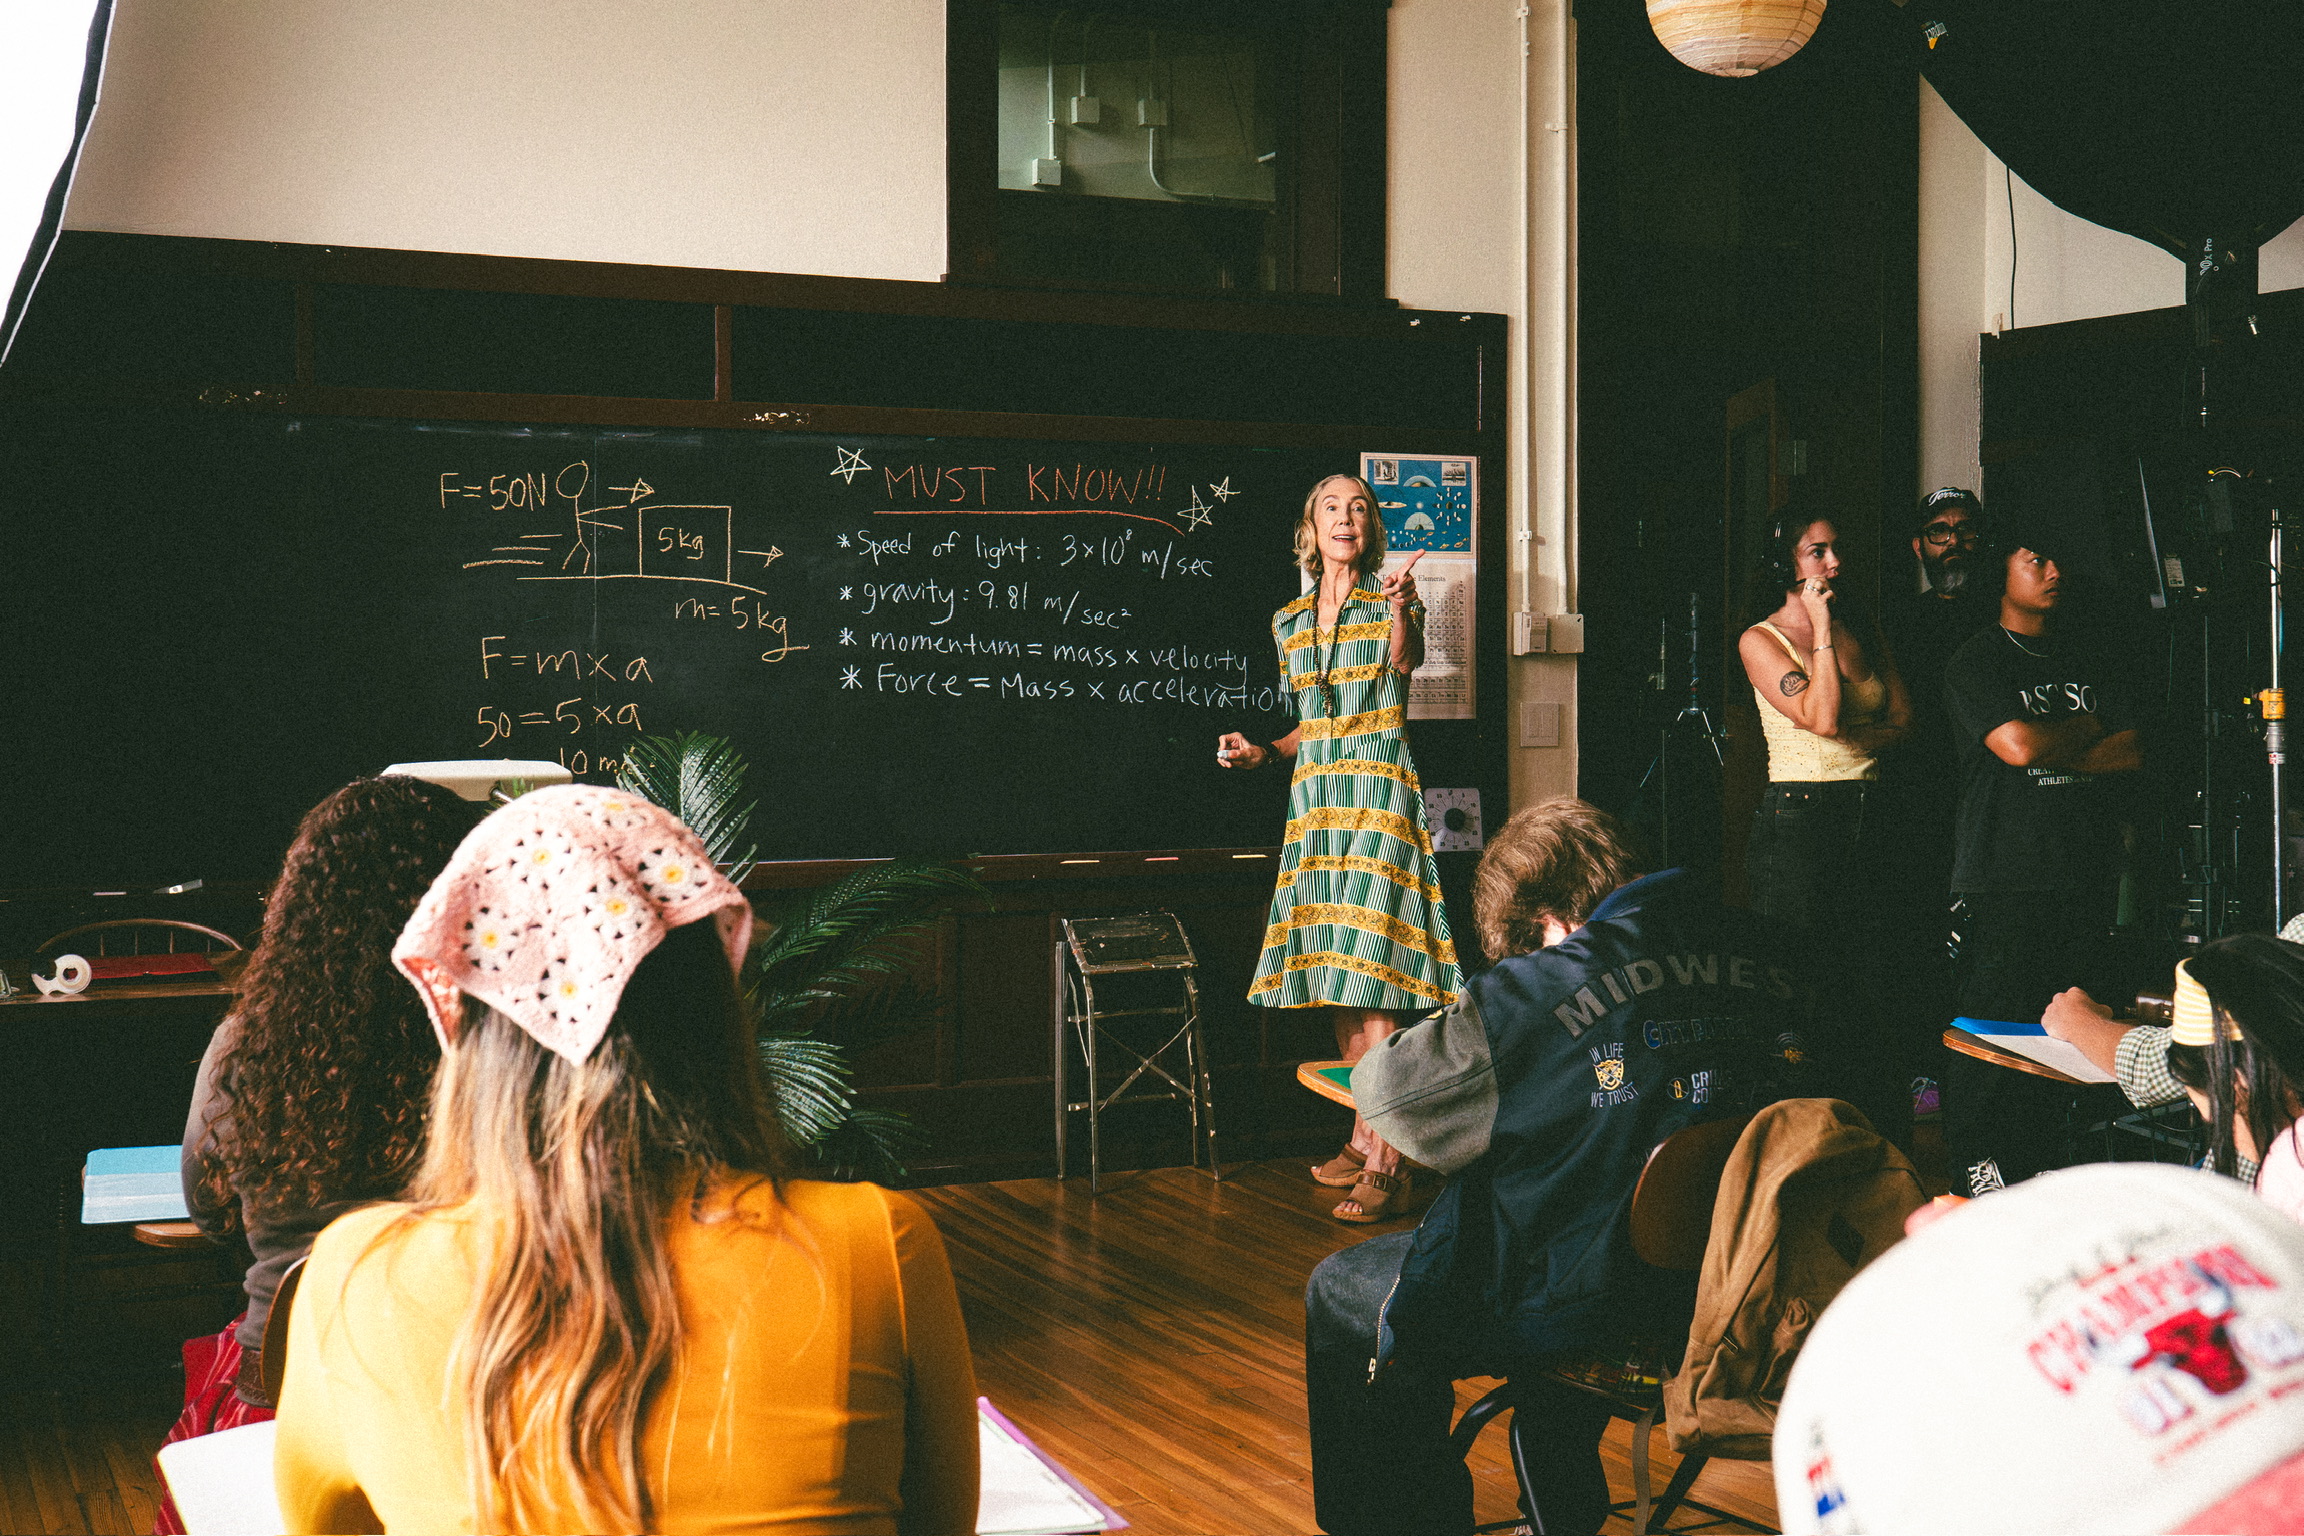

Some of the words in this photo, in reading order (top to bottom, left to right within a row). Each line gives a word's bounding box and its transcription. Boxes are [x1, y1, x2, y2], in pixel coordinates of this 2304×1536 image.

[2203, 237, 2213, 252] Pro
[884, 465, 997, 505] MUST
[1028, 463, 1166, 503] KNOW!!
[932, 530, 960, 555] of
[1141, 541, 1213, 579] m/sec
[1417, 574, 1446, 583] Elements
[978, 580, 1028, 611] 9.81
[870, 631, 1021, 659] momentum
[1053, 644, 1118, 669] mass
[1149, 644, 1247, 691] velocity
[877, 662, 963, 697] Force
[1000, 672, 1075, 700] Mass
[1118, 676, 1293, 718] acceleration
[2037, 775, 2074, 786] ATHLETES
[1552, 953, 1799, 1040] MIDWES
[1588, 1046, 1602, 1063] IN
[1602, 1042, 1624, 1059] LIFE
[1590, 1091, 1604, 1108] WE
[1607, 1081, 1639, 1106] TRUST
